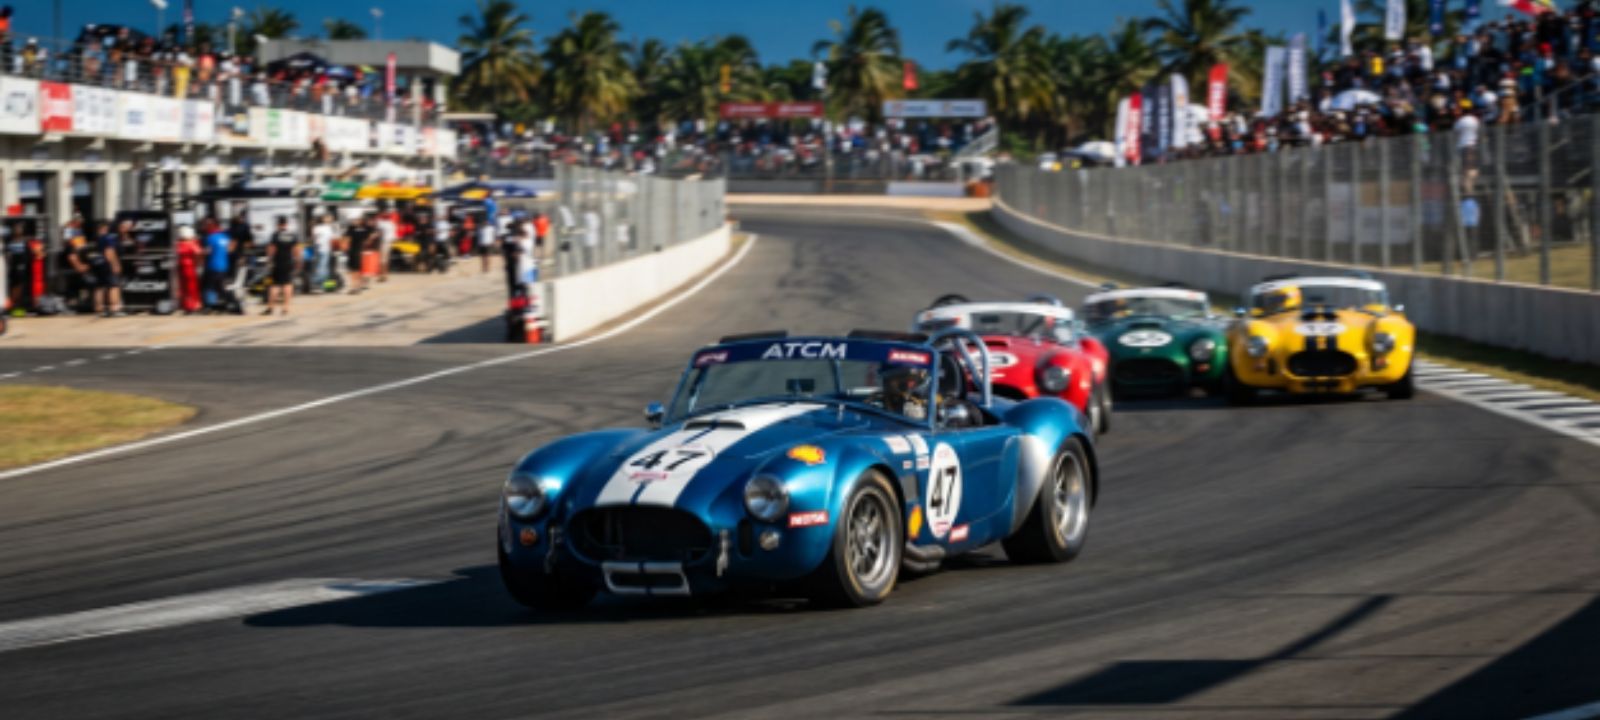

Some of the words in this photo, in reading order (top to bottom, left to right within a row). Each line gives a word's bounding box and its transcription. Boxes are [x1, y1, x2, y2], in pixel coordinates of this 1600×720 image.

[761, 342, 848, 360] ATCM
[629, 450, 705, 472] 47
[931, 465, 957, 517] 47
